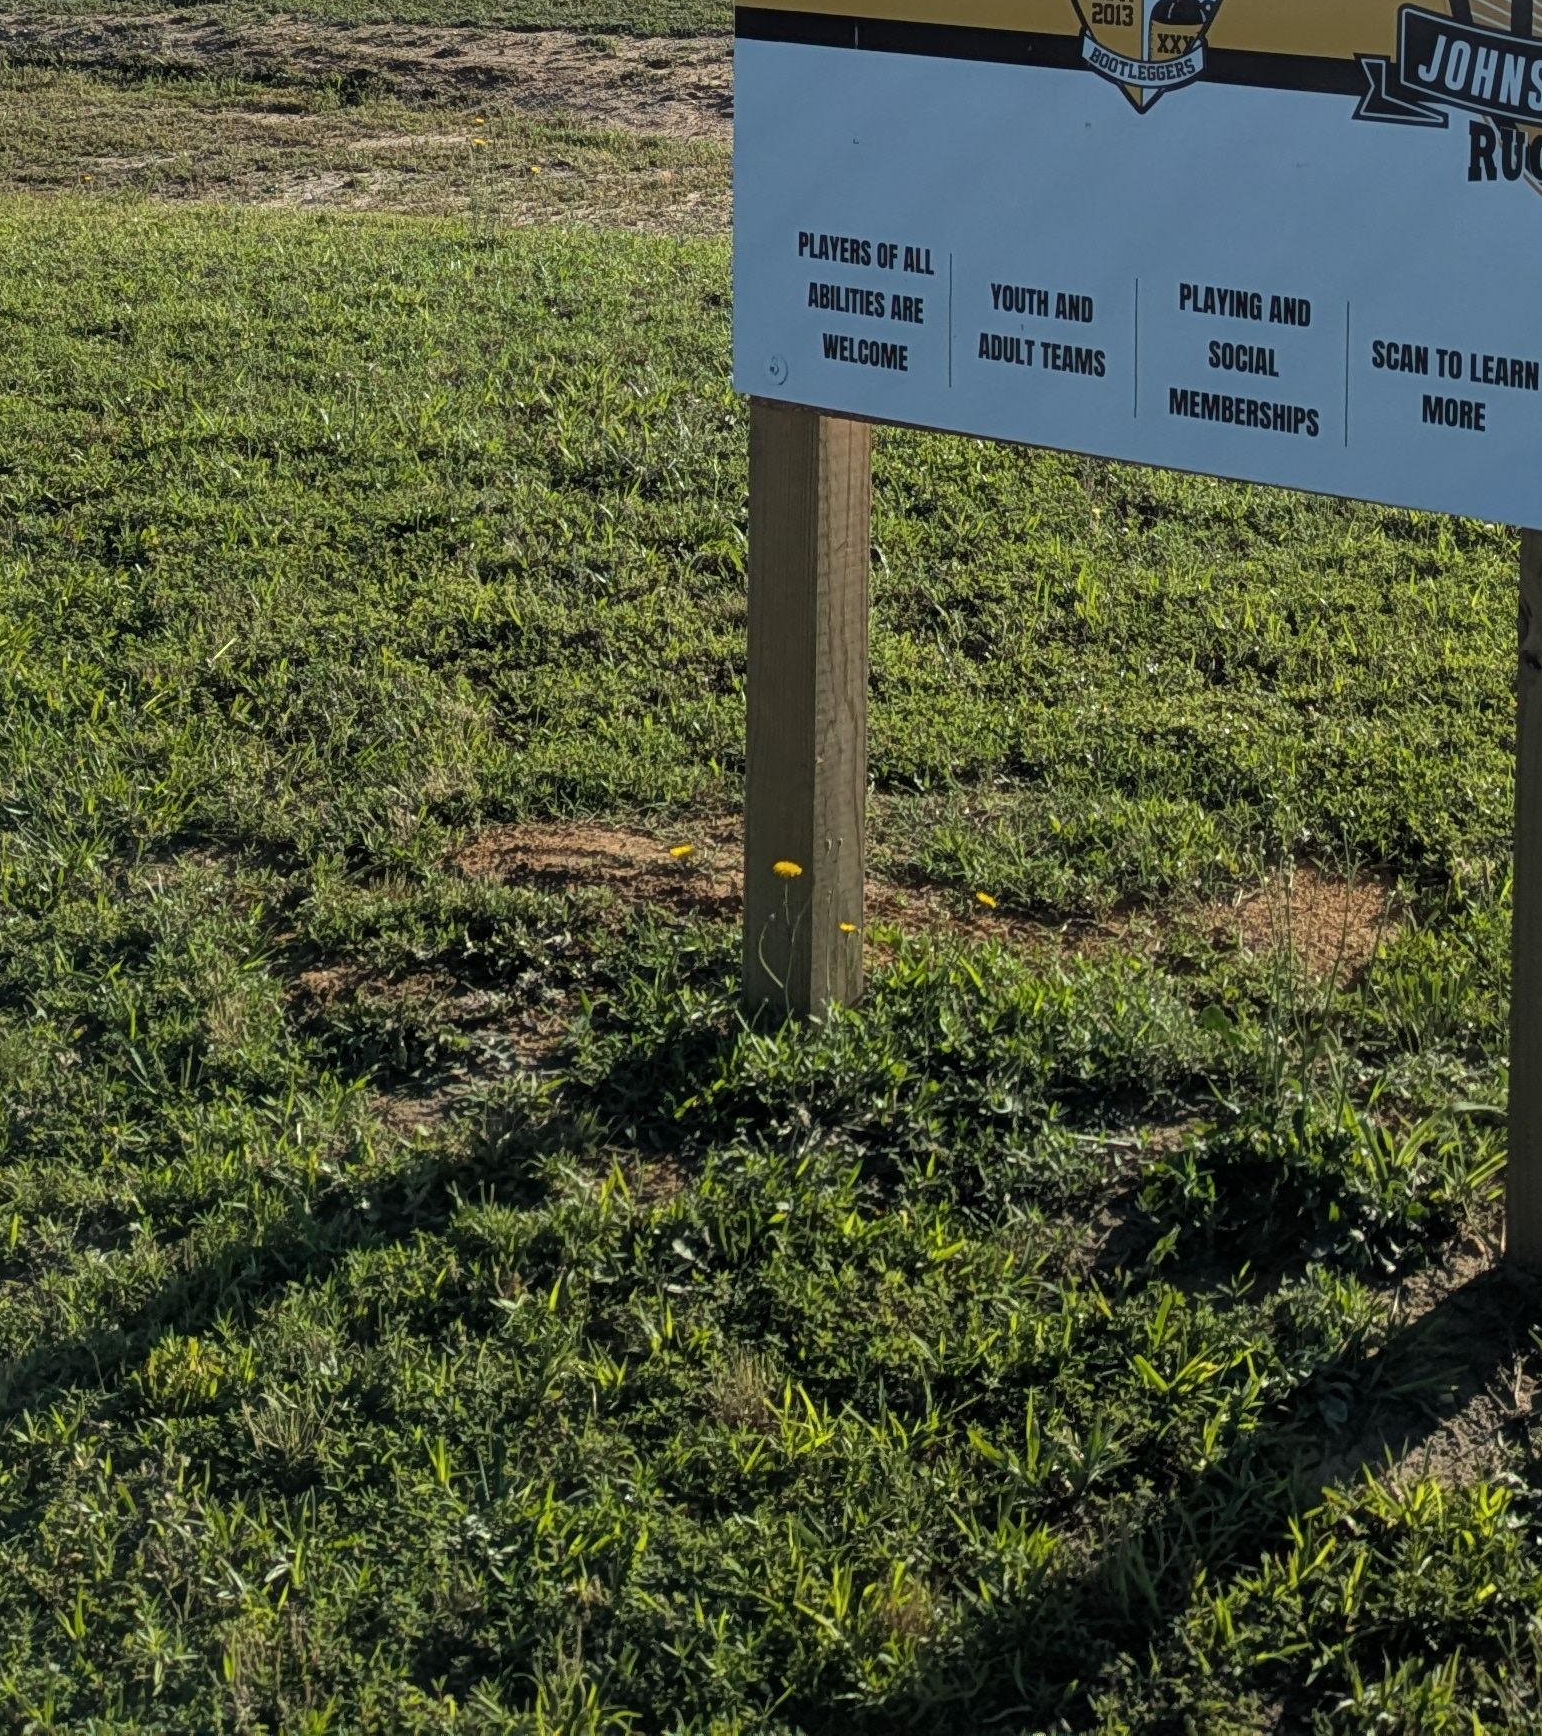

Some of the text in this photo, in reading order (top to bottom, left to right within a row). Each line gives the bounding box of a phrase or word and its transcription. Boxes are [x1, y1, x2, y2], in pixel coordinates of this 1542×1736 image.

[1092, 3, 1134, 27] 2013
[1088, 47, 1196, 82] BOOTLEGGERS
[1157, 33, 1198, 56] XXX
[798, 231, 935, 276] PLAYERS OF ALL
[808, 282, 924, 324] ABILITIES ARE
[990, 282, 1094, 324] YOUTH AND
[1179, 282, 1312, 328] PLAYING AND
[822, 333, 908, 372] WELCOME
[978, 332, 1106, 379] ADULT TEAMS
[1208, 340, 1280, 378] SOCIAL
[1372, 340, 1540, 391] SCAN TO LEARN
[1168, 387, 1320, 438] MEMBERSHIPS
[1422, 394, 1486, 432] MORE
